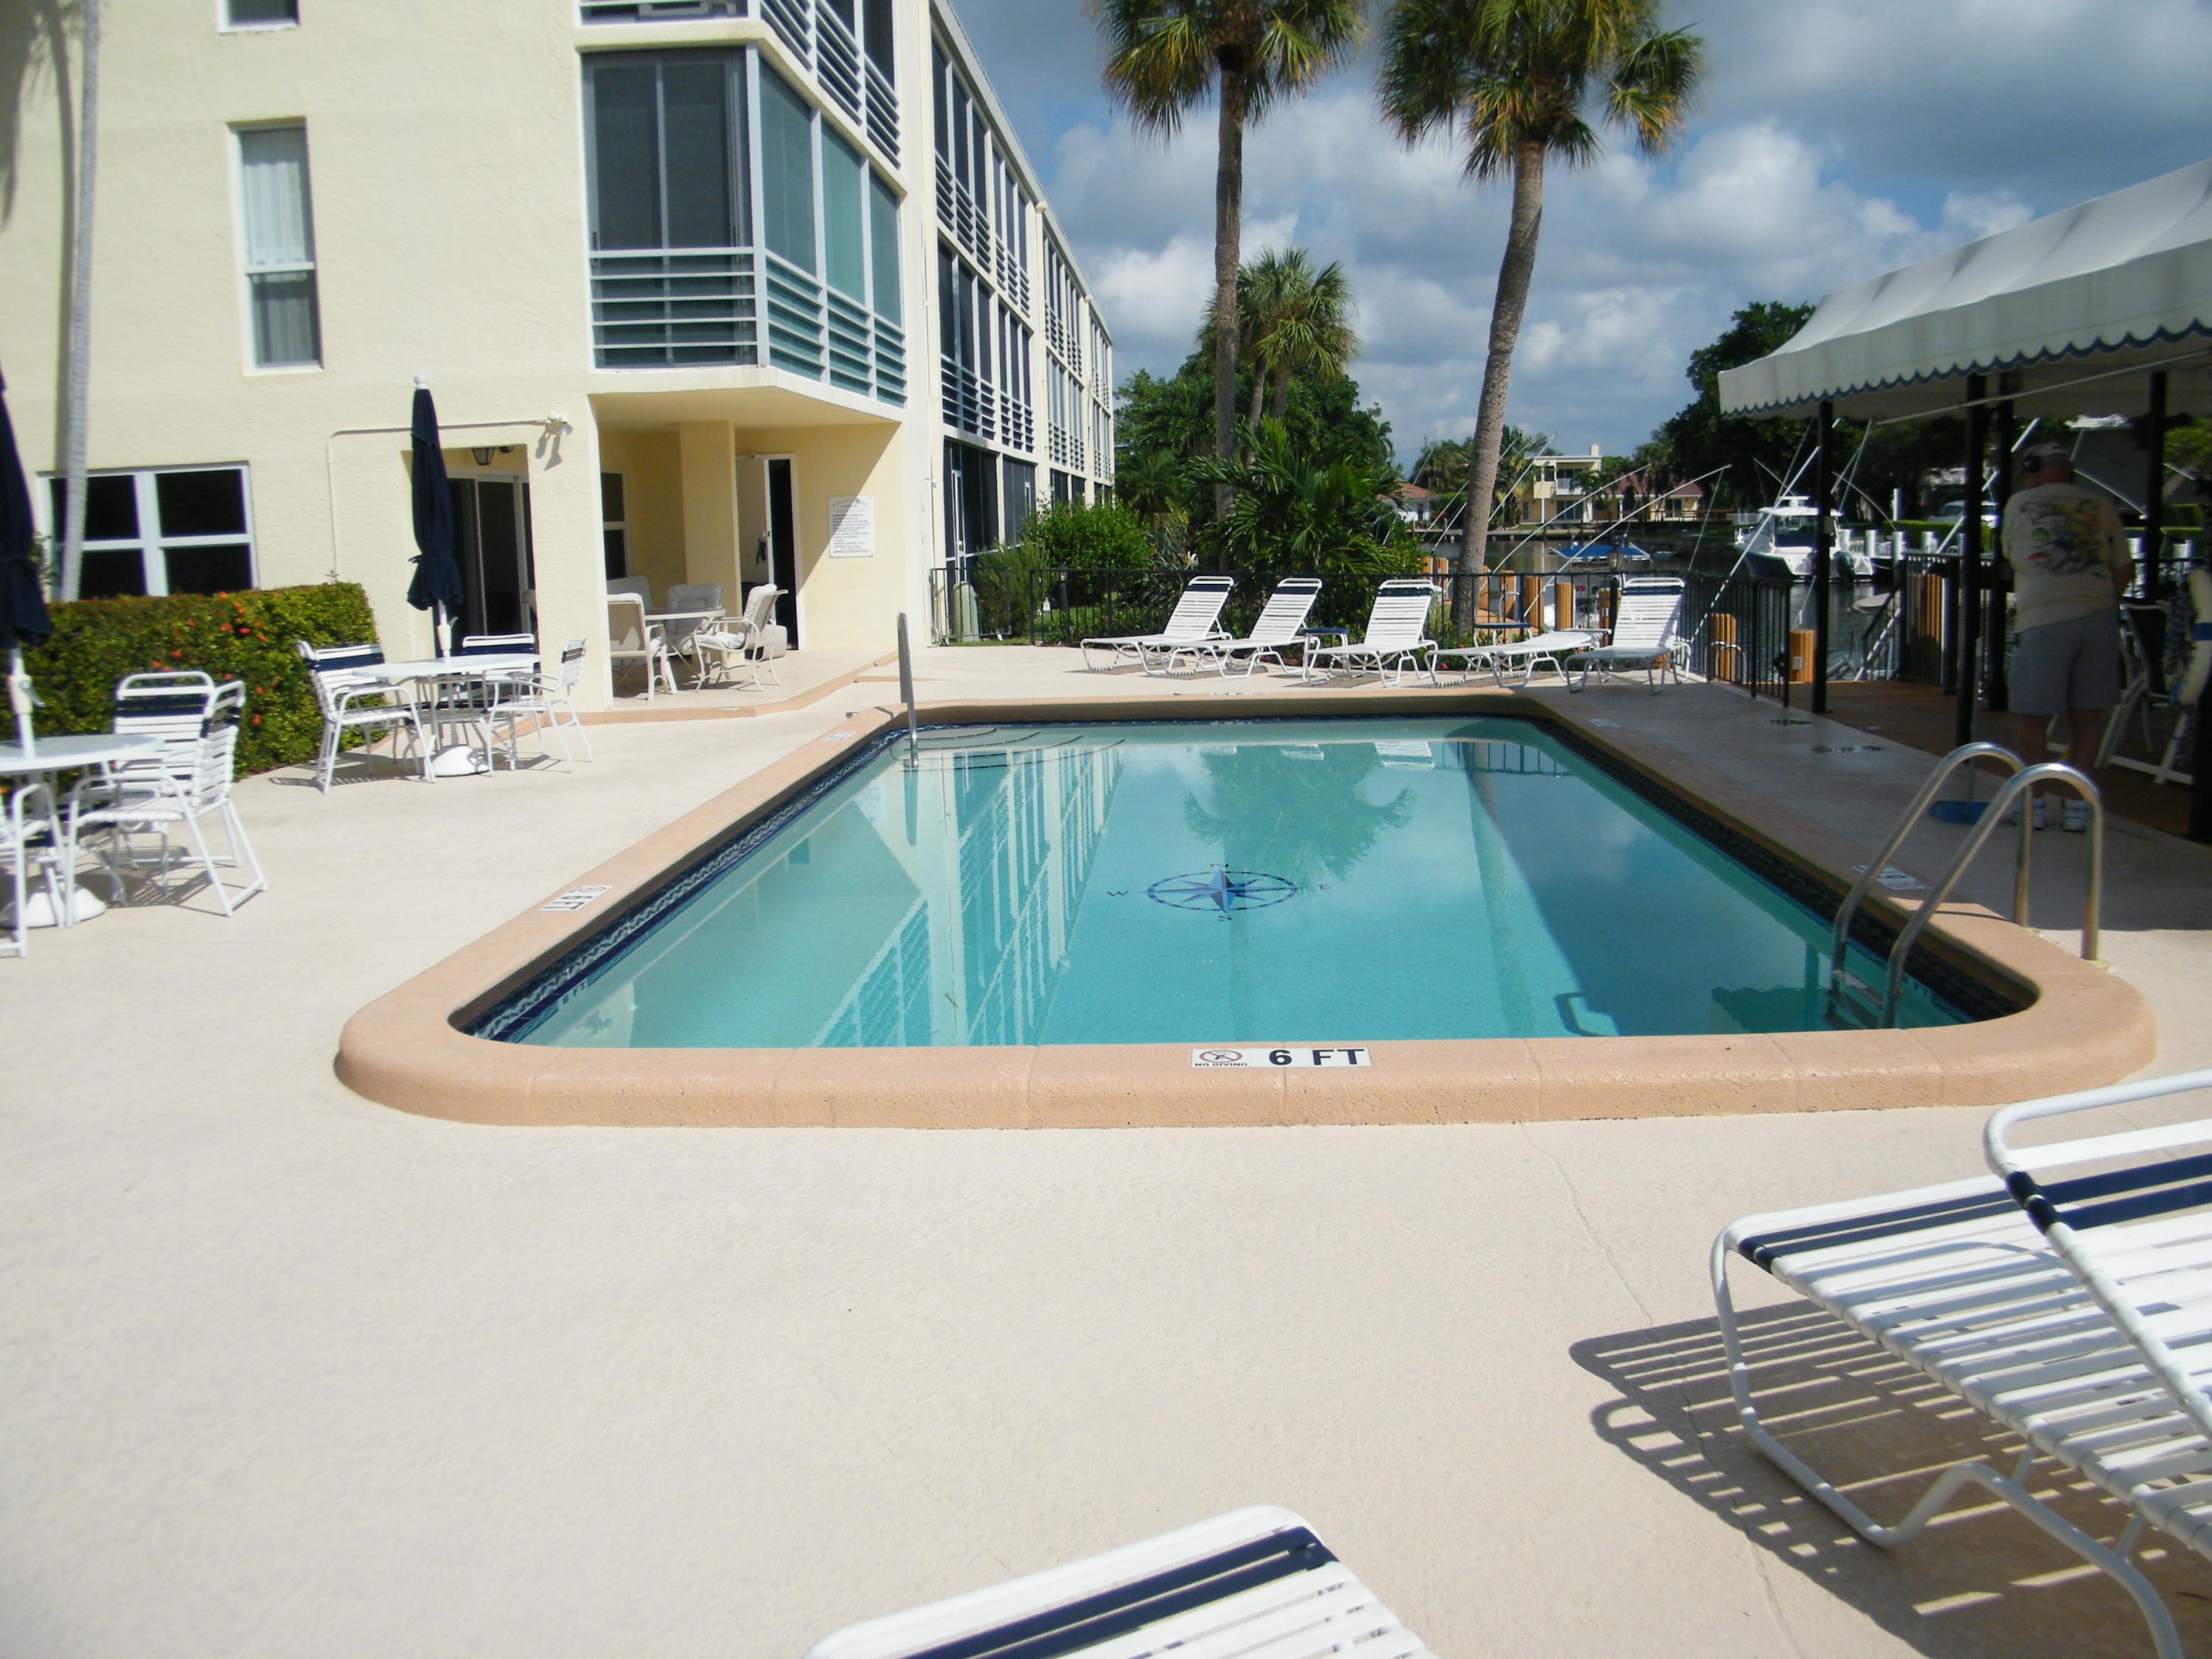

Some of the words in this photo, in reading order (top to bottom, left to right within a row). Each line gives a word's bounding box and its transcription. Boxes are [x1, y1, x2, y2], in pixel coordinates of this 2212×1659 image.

[574, 981, 585, 996] FT
[1269, 1049, 1292, 1065] 6
[1312, 1048, 1365, 1065] FT
